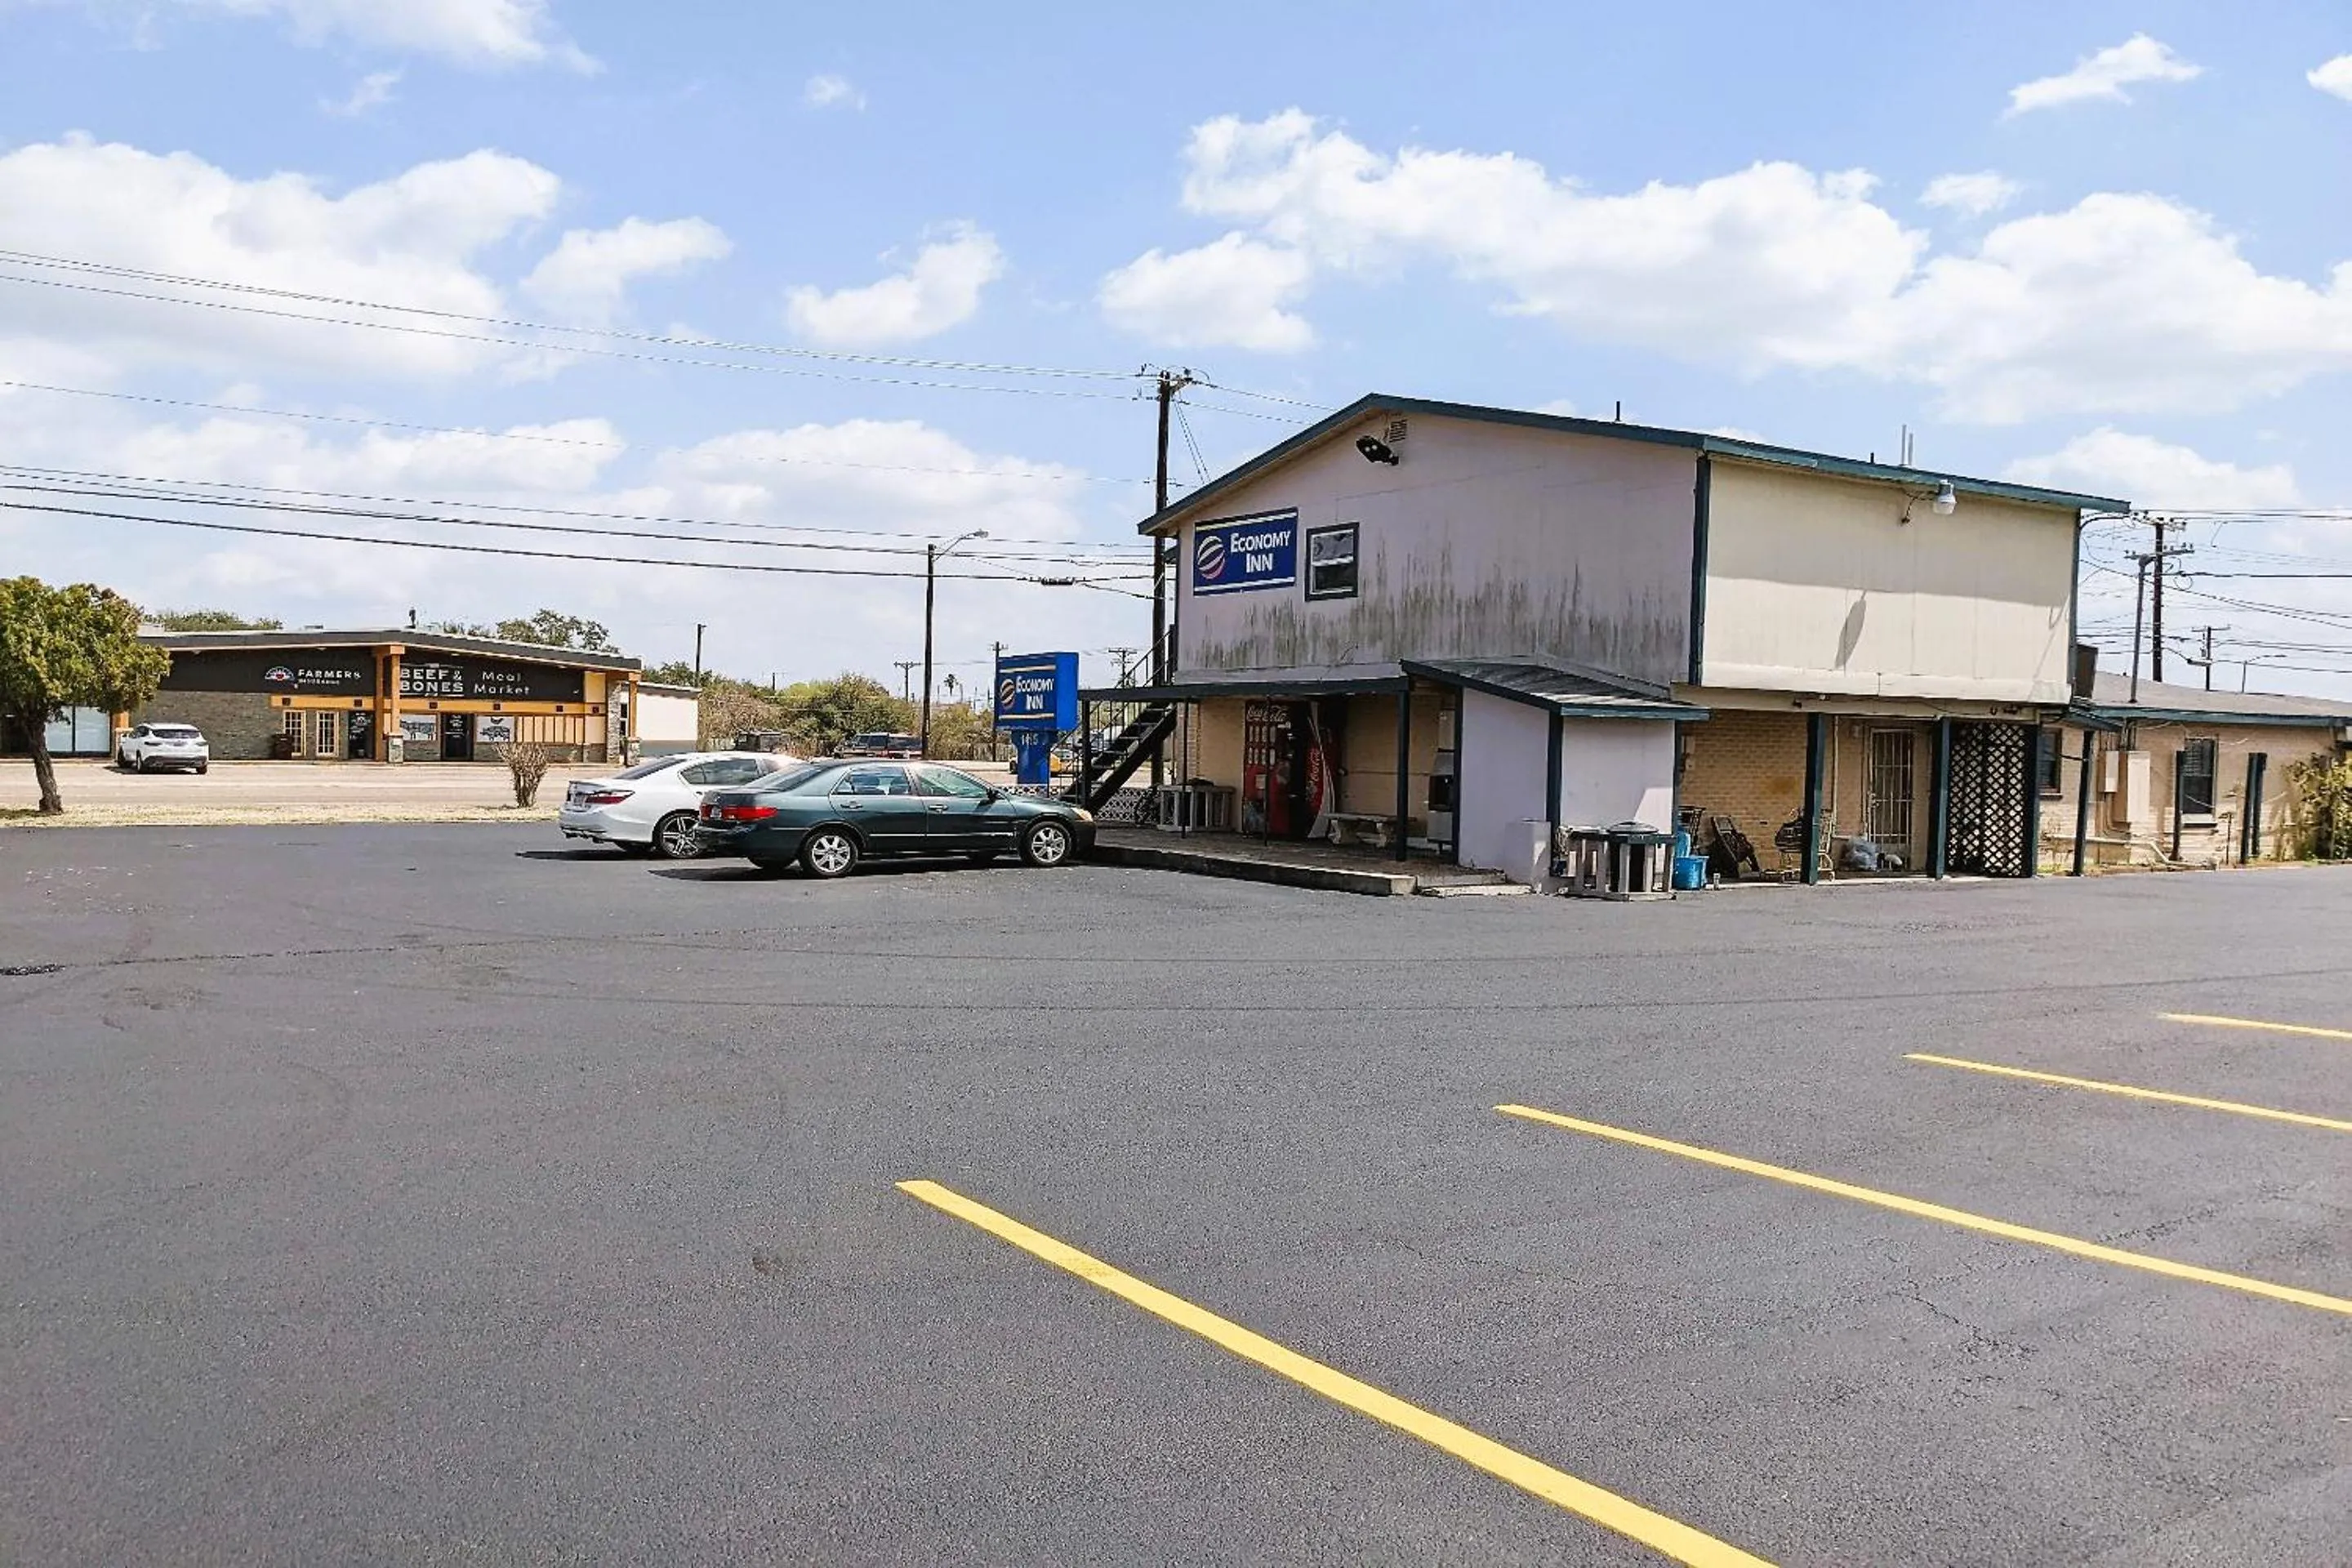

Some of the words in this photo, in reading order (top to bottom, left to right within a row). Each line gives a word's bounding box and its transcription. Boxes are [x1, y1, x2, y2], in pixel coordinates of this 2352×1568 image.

[1230, 531, 1291, 553] ECONOMY
[1246, 553, 1273, 573] INN
[298, 669, 361, 679] FARMERS
[399, 668, 449, 680] BEEF
[452, 670, 462, 680] &
[399, 680, 464, 693] BONES
[474, 683, 530, 695] Market
[1015, 675, 1054, 693] ECONOMY
[1026, 693, 1044, 710] INN
